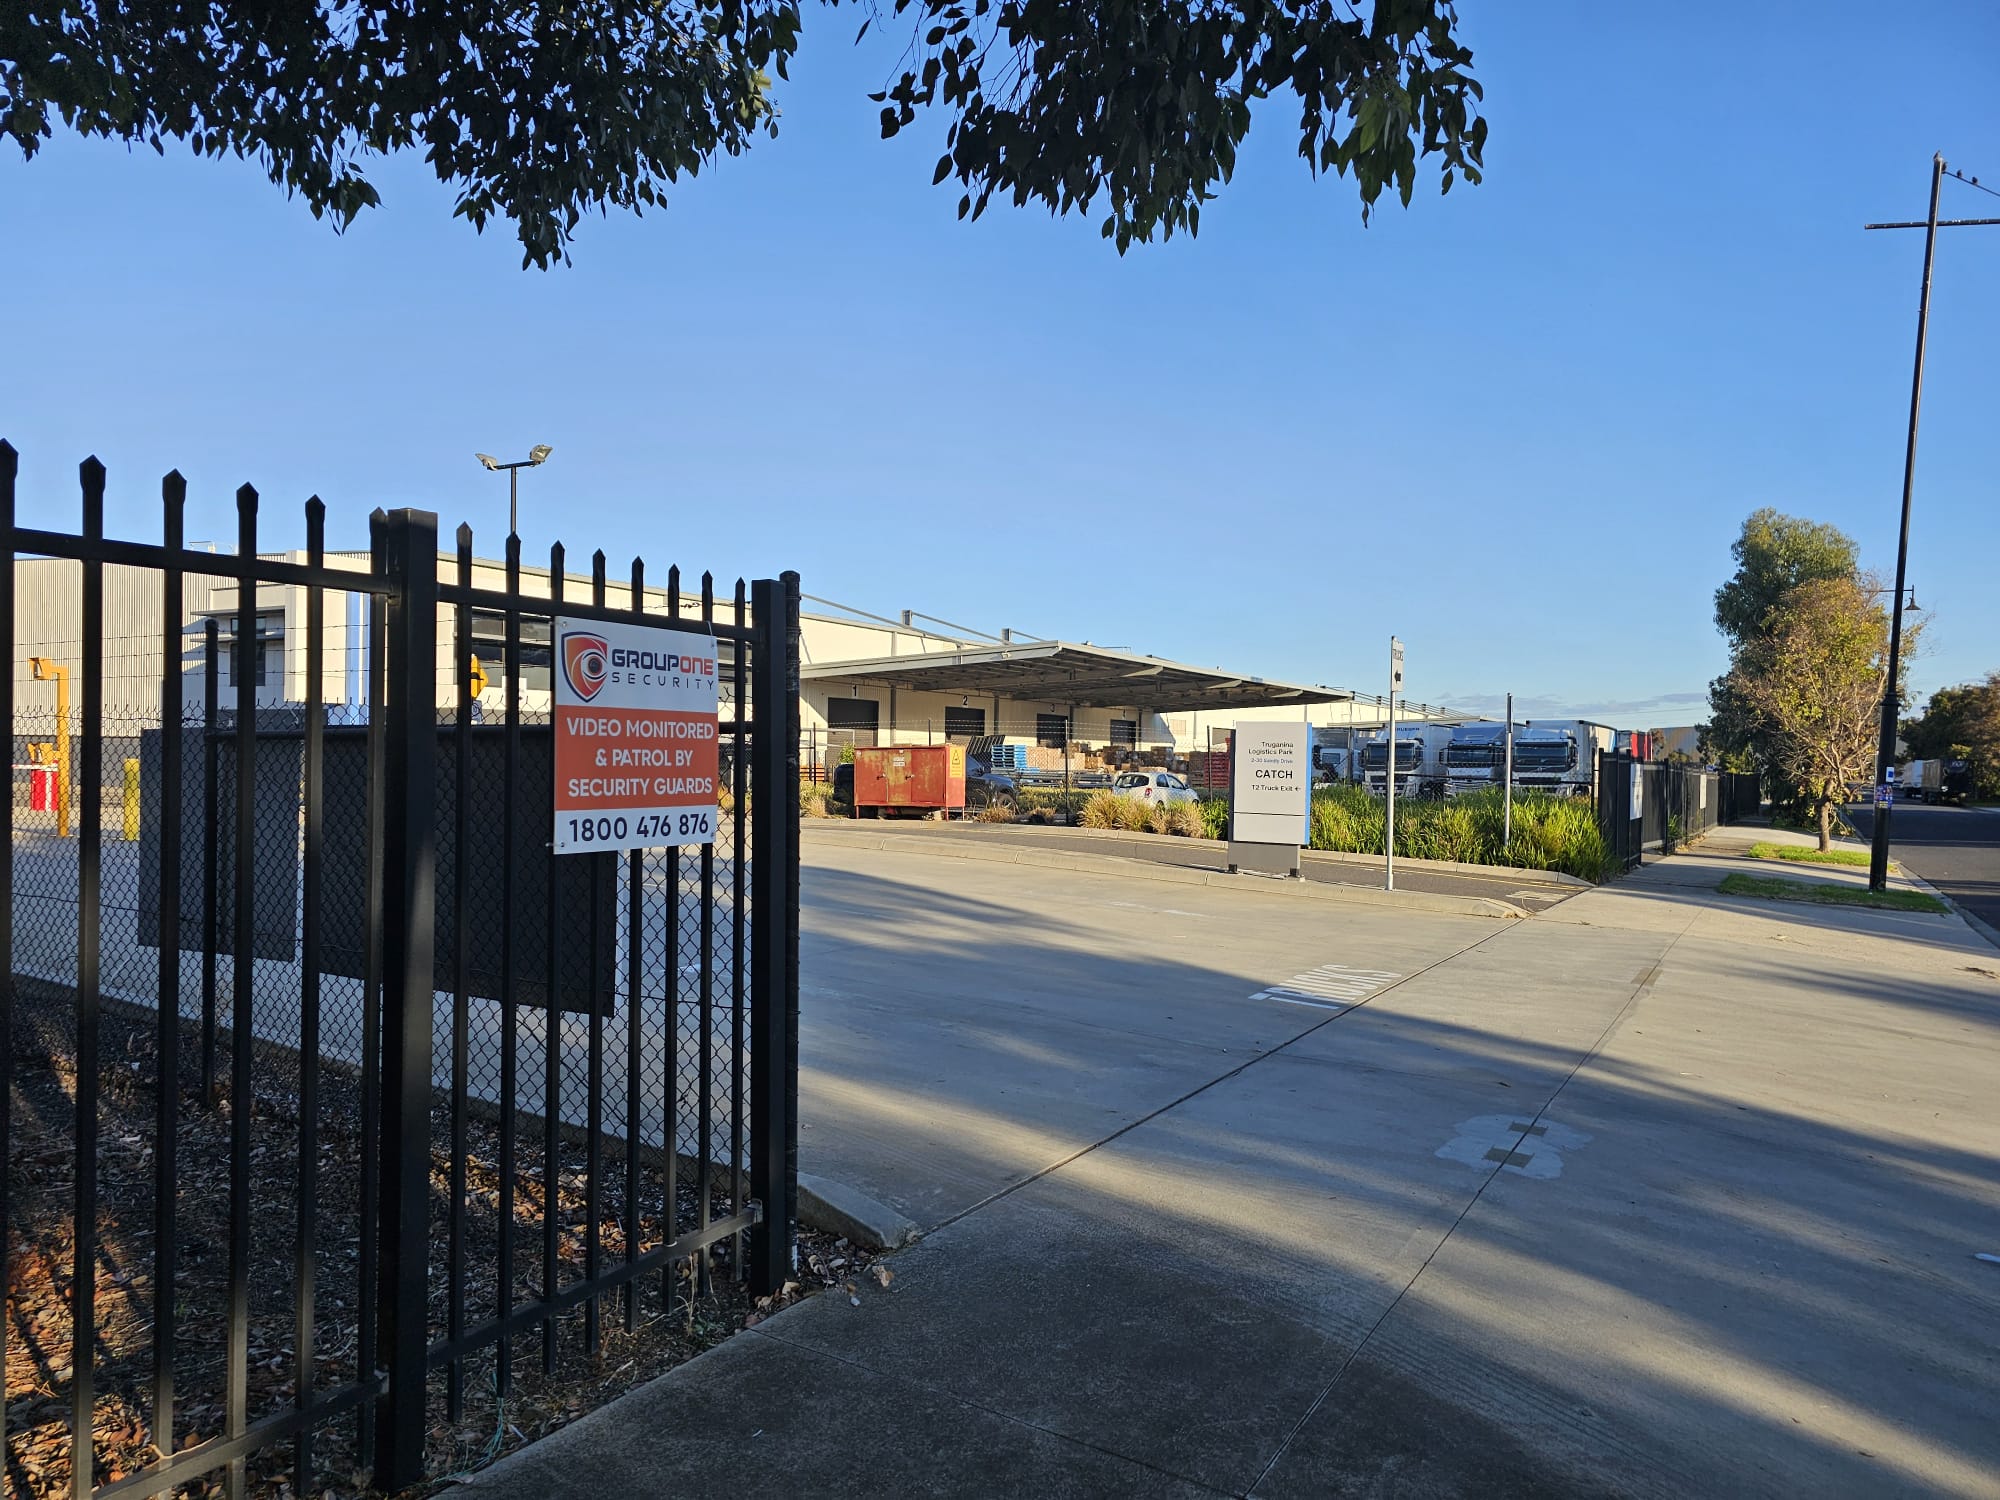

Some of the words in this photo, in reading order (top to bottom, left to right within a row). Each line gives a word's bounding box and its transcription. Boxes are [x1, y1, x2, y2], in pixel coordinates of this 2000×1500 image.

[611, 671, 715, 691] SECURITY
[566, 717, 622, 737] VIDEO
[626, 719, 714, 740] MONITORED
[1248, 748, 1277, 756] Logistics
[1261, 741, 1294, 749] Truganina
[595, 748, 607, 767] &
[612, 748, 672, 767] PATROL
[675, 749, 693, 767] BY
[1255, 769, 1293, 779] CATCH
[568, 778, 650, 797] SECURITY
[653, 777, 713, 796] GUARDS
[569, 817, 628, 842] 1800
[636, 815, 671, 838] 476
[679, 813, 709, 836] 876
[1247, 964, 1402, 1010] TRUCKS
